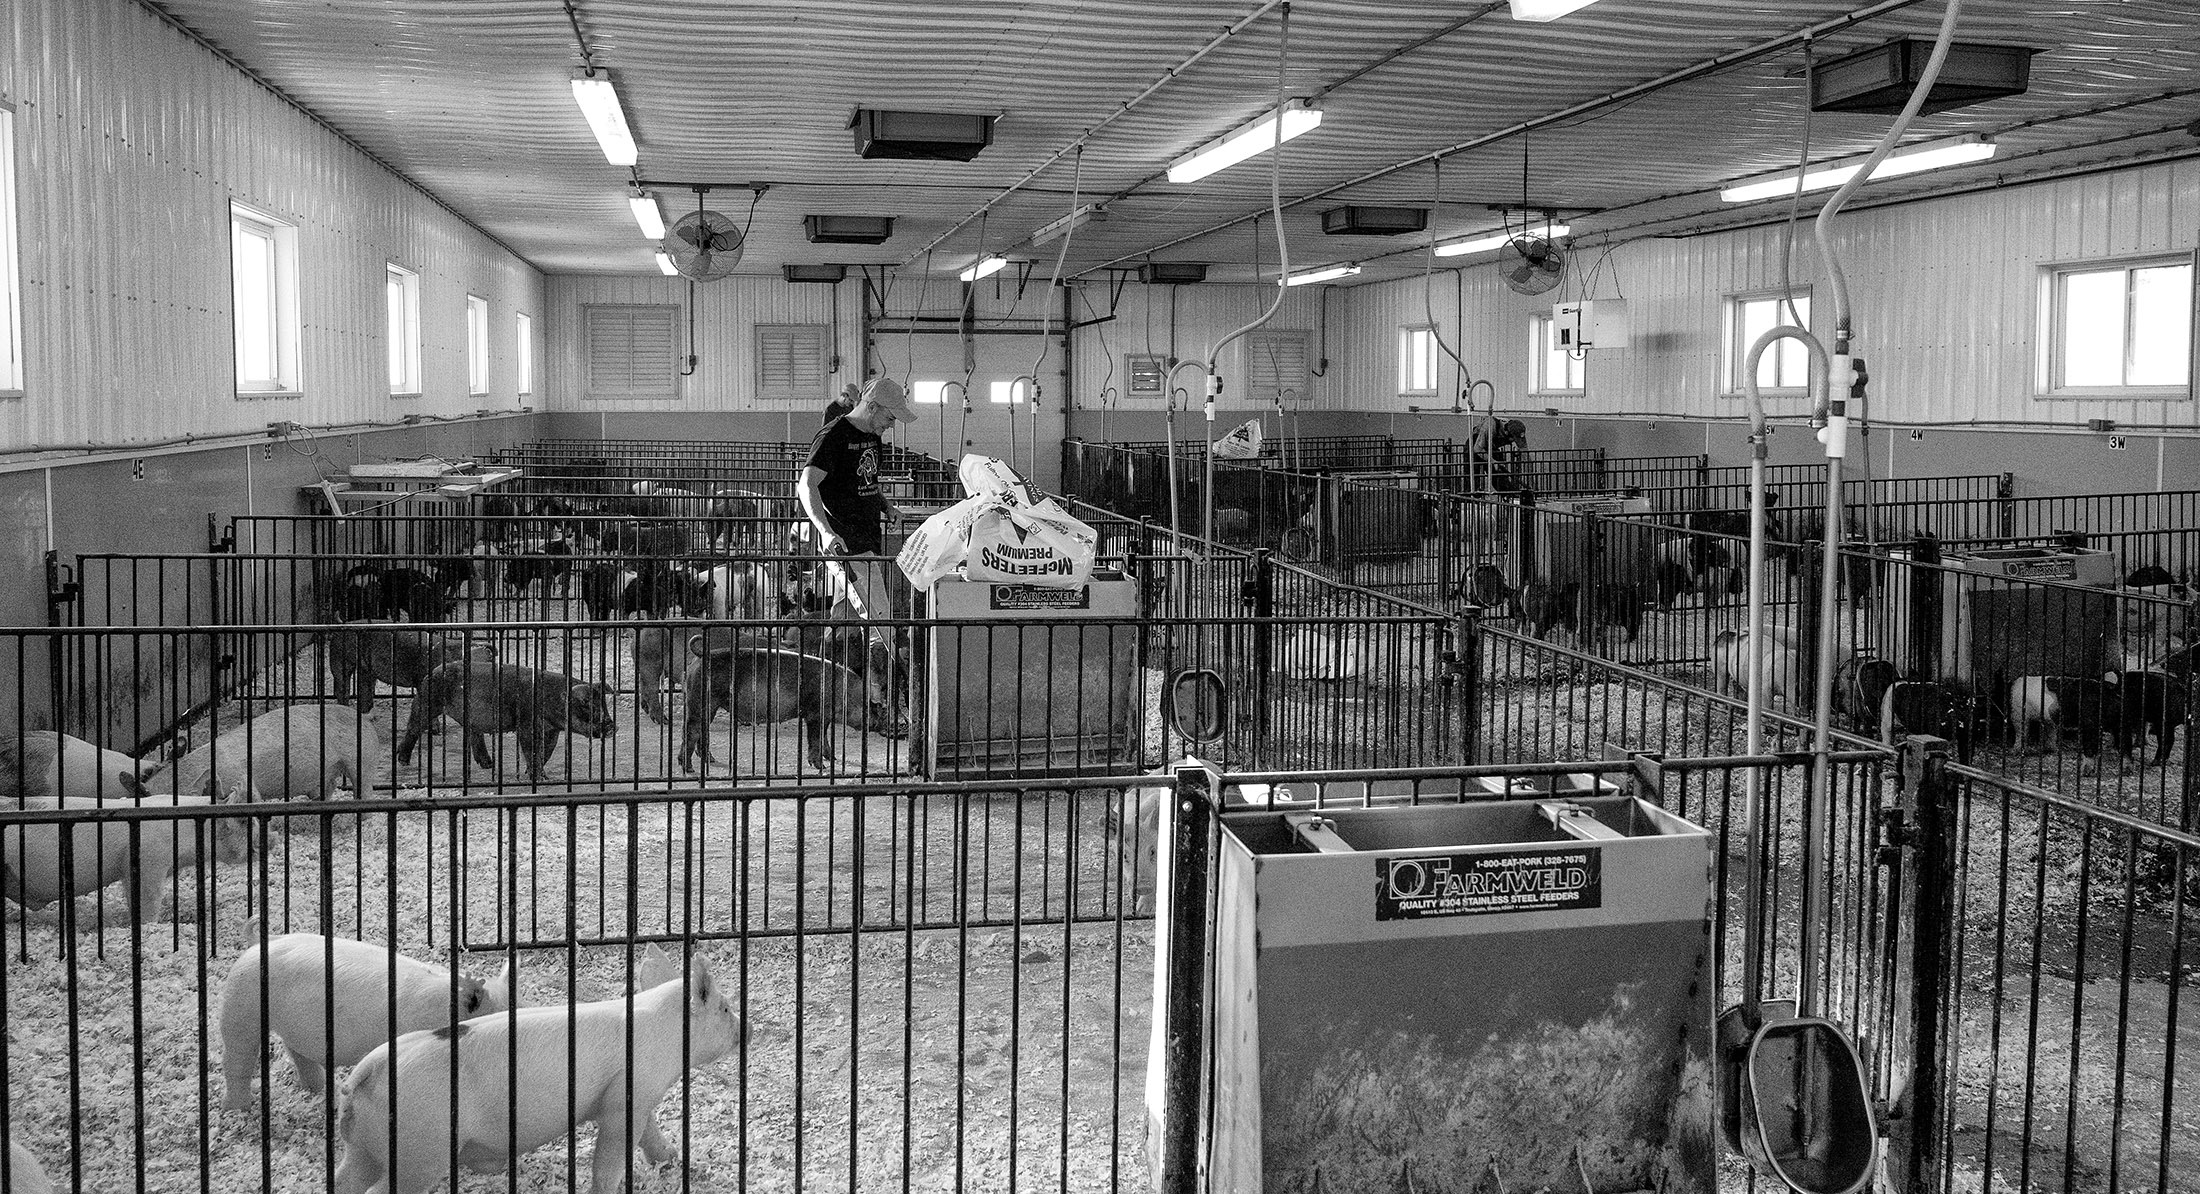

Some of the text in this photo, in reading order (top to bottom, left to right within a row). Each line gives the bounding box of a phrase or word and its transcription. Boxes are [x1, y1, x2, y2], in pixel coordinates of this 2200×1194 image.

[1766, 425, 1776, 435] 5W
[1911, 429, 1924, 441] 4W
[2110, 436, 2126, 449] 3W
[133, 459, 144, 480] 4E
[996, 543, 1053, 560] PREMIUM
[981, 546, 1073, 575] McFEETERS
[1475, 854, 1587, 869] 1-800-EAT-PORK (328-7675)
[1433, 867, 1587, 896] FARMWELD
[1398, 899, 1438, 910] QUALITY
[1462, 895, 1509, 907] STAINLESS
[1510, 893, 1539, 904] STEEL
[1539, 891, 1580, 902] FEEDERS
